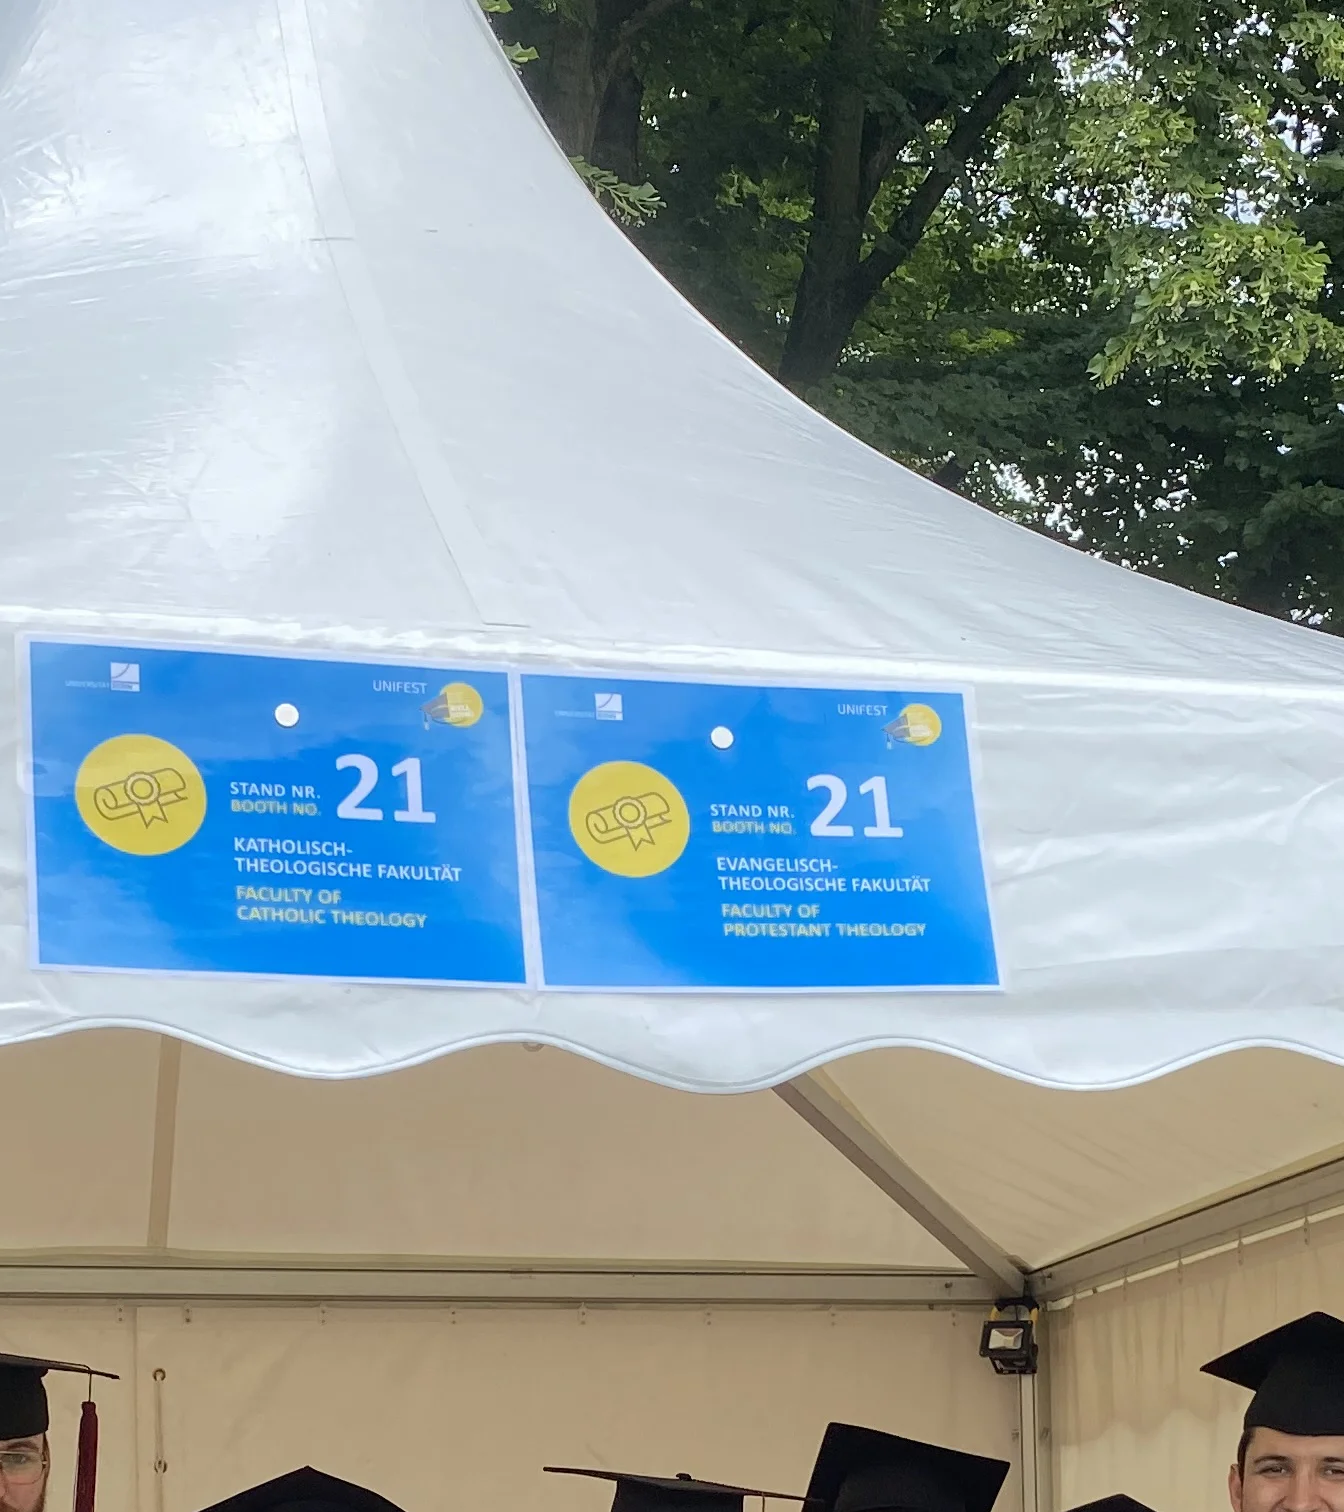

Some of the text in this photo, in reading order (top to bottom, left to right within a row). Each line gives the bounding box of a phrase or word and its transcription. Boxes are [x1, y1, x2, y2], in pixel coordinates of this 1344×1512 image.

[372, 680, 428, 694] UNIFEST
[837, 703, 888, 716] UNIFEST
[230, 781, 321, 799] STAND NR.
[335, 753, 437, 824] 21
[231, 799, 322, 816] BOOTH NO.
[710, 803, 795, 819] STAND NR.
[806, 773, 904, 839] 21
[712, 820, 797, 836] BOOTH NO.
[233, 837, 354, 857] KATHOLISCH-
[234, 857, 463, 883] THEOLOGISCHE FAKULTÄT
[716, 856, 839, 873] EVANGELISCH-
[718, 875, 931, 892] THEOLOGISCHE FAKULTÄT
[235, 885, 342, 905] FACULTY OF
[236, 905, 428, 929] CATHOLIC THEOLOGY
[721, 903, 821, 919] FACULTY OF
[723, 923, 927, 938] PROTESTANT THEOLOGY
